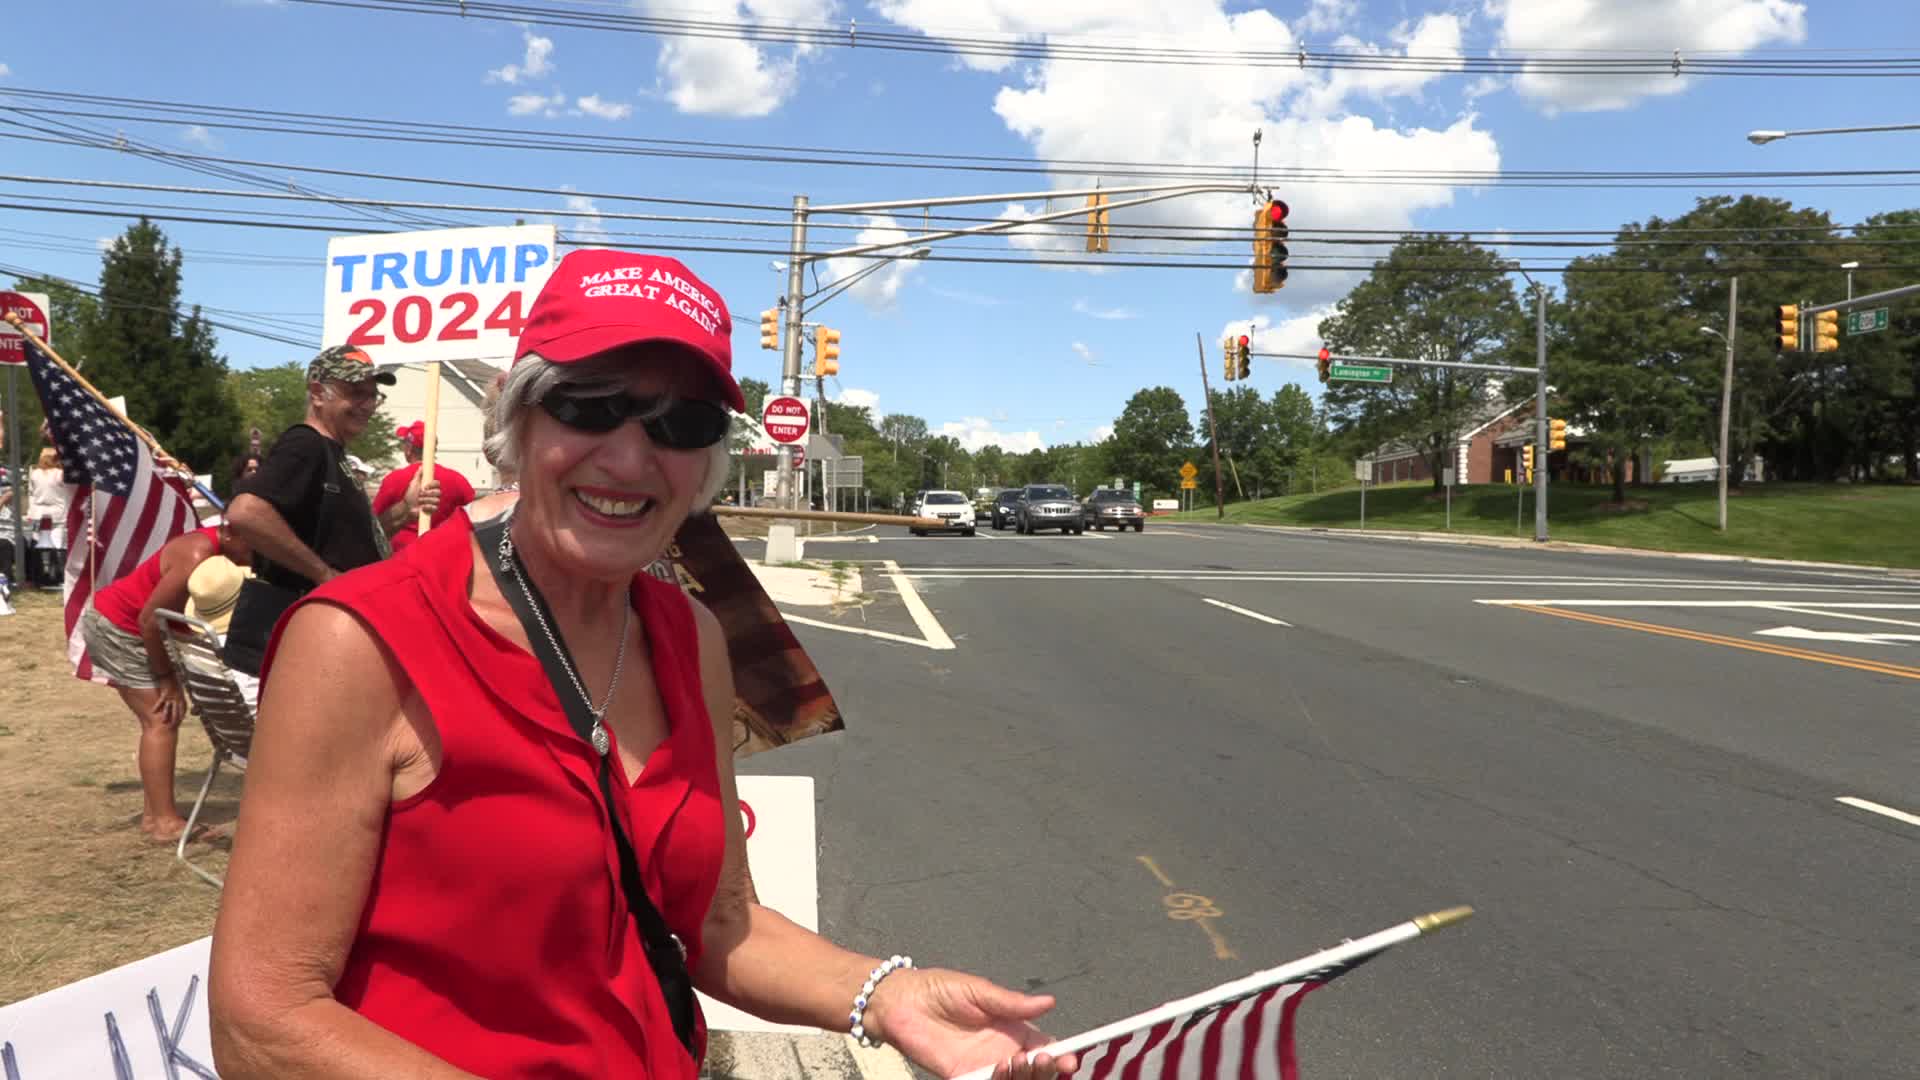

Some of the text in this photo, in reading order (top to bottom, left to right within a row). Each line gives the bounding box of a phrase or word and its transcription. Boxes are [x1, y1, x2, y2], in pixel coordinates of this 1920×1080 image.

[332, 244, 549, 293] TRUMP
[346, 290, 531, 346] 2024
[579, 266, 723, 325] MAKE AMERICA
[584, 283, 718, 337] GREAT AGAIN
[771, 405, 802, 415] DO NOT
[772, 425, 798, 436] ENTER
